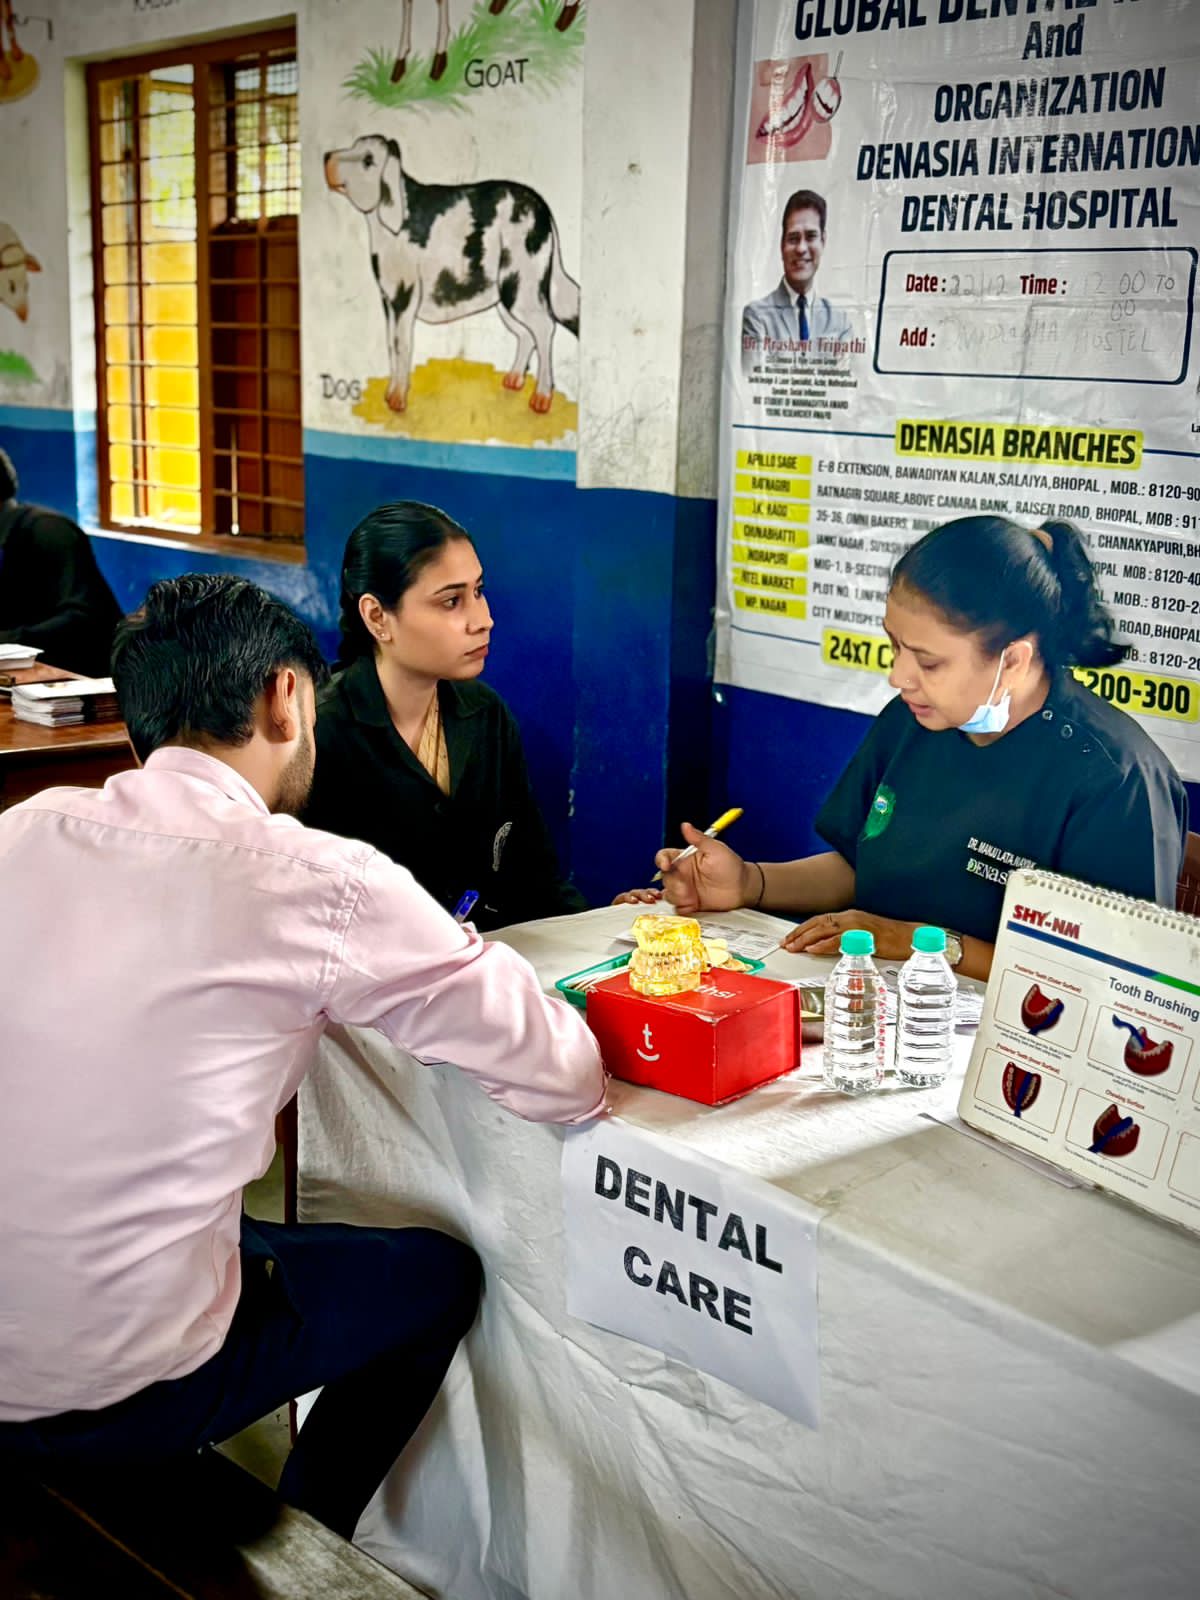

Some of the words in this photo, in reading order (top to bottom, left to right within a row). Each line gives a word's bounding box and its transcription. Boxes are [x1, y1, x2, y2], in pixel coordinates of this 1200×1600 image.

[795, 0, 927, 40] GLOBAL
[1022, 13, 1085, 60] And
[464, 58, 529, 88] GOAT
[934, 66, 1167, 123] ORGANIZATION
[856, 138, 979, 181] DENASIA
[901, 193, 1012, 232] DENTAL
[1022, 186, 1178, 230] HOSPITAL
[816, 337, 867, 356] Tripathi
[319, 374, 361, 400] DOG
[900, 423, 996, 456] DENASIA
[1002, 428, 1137, 465] BRANCHES
[837, 461, 893, 479] EXTENSION,
[895, 466, 957, 483] BAWADIYAN
[937, 496, 977, 510] CANARA
[1016, 501, 1055, 516] RAISEN
[1095, 507, 1142, 525] BHOPAL,
[830, 635, 872, 666] 24x7
[1013, 904, 1081, 941] SHY-NM
[1108, 976, 1141, 1000] Tooth
[1144, 989, 1200, 1023] Brushing
[594, 1154, 783, 1274] DENTAL
[623, 1245, 753, 1336] CARE
